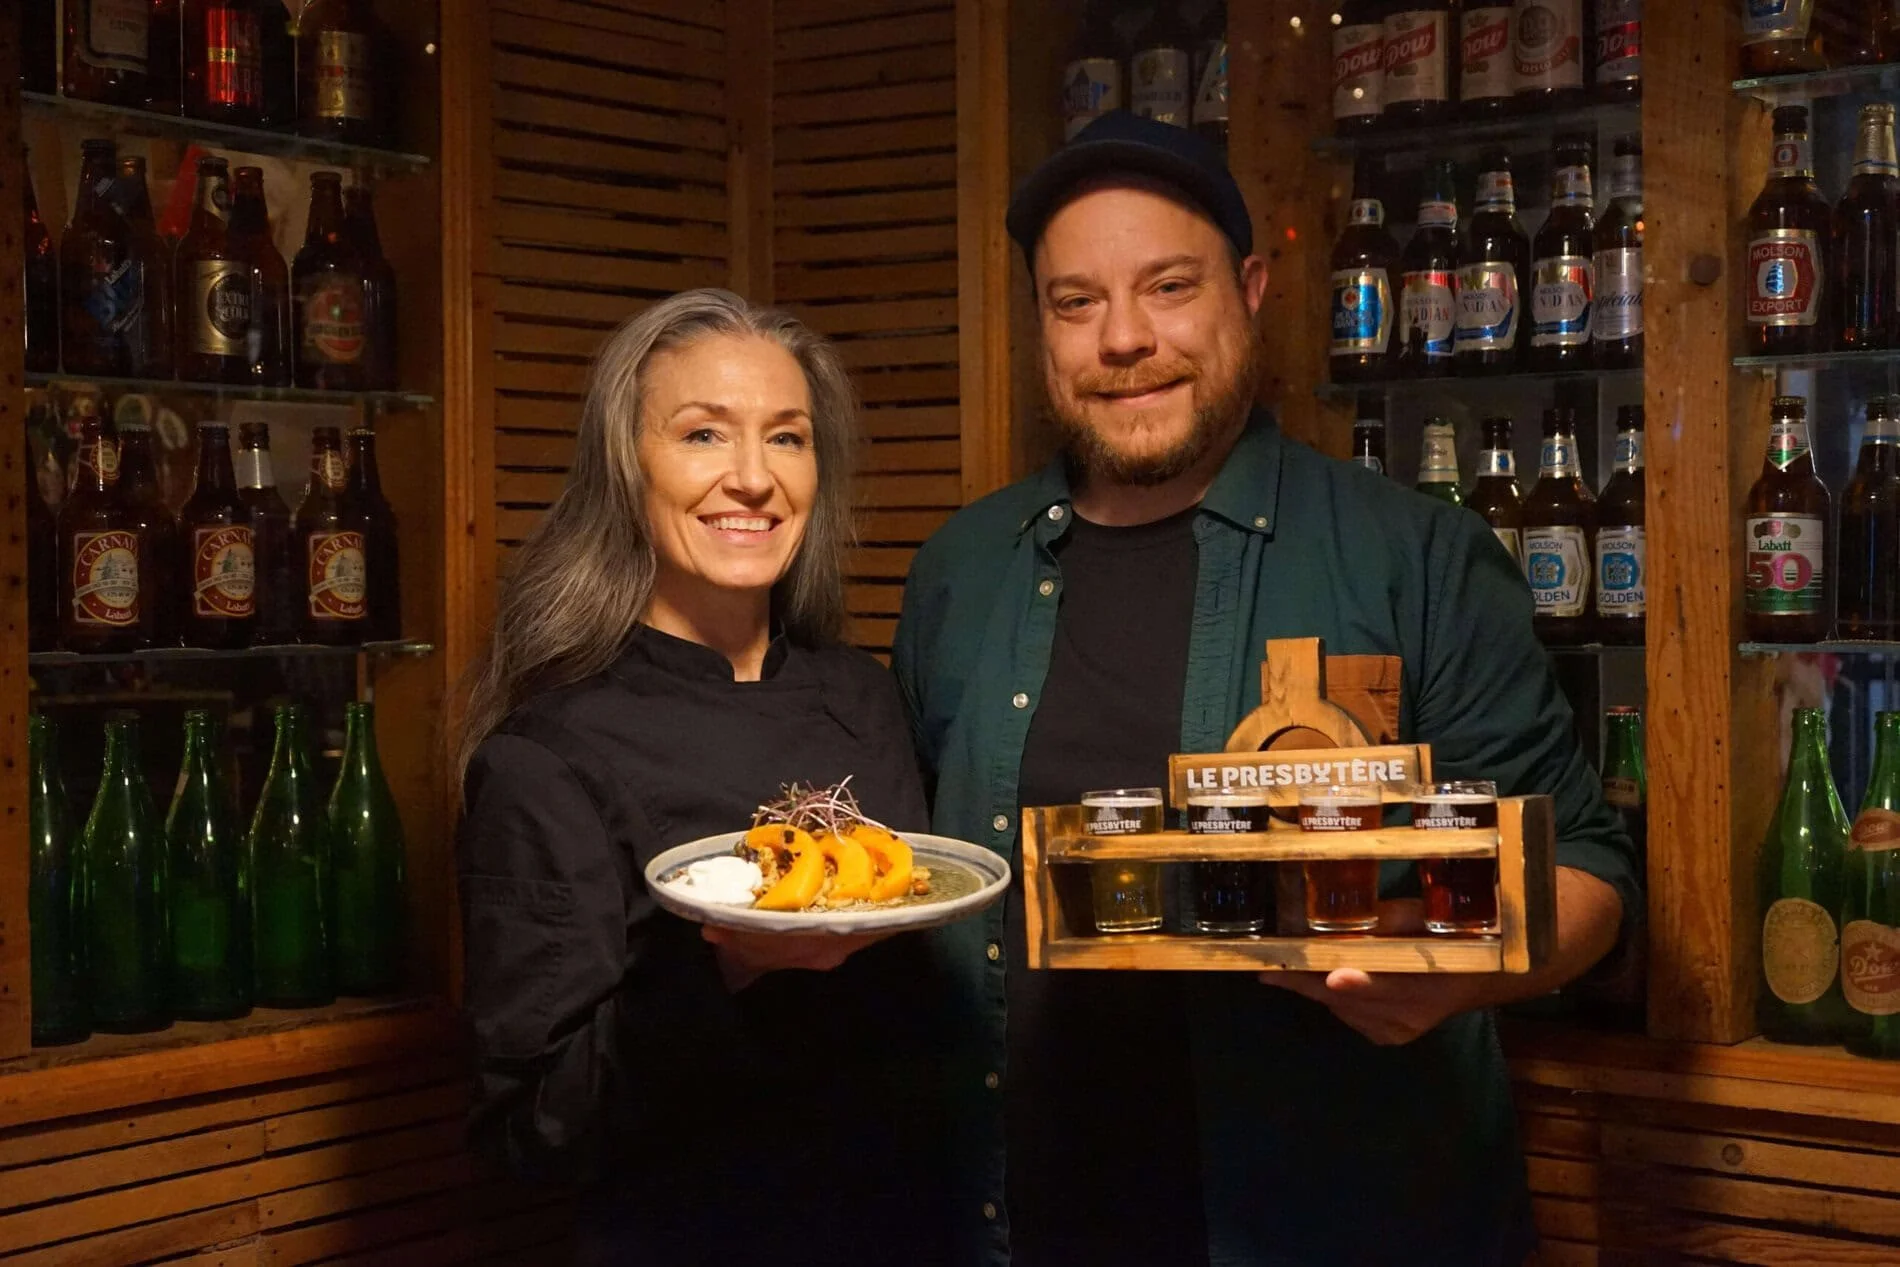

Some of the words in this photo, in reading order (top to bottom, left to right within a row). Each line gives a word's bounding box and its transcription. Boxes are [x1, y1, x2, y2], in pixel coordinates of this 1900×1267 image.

[1752, 245, 1805, 260] MOLSON
[1752, 298, 1803, 313] EXPORT
[1758, 539, 1792, 551] Labatt
[1746, 552, 1813, 592] 50
[1531, 590, 1571, 602] OLDEN
[1599, 591, 1644, 603] GOLDEN
[1187, 767, 1218, 789] LE
[1222, 758, 1406, 788] PRESBYTÈRE
[1197, 819, 1253, 830] PRESBYTÈRE
